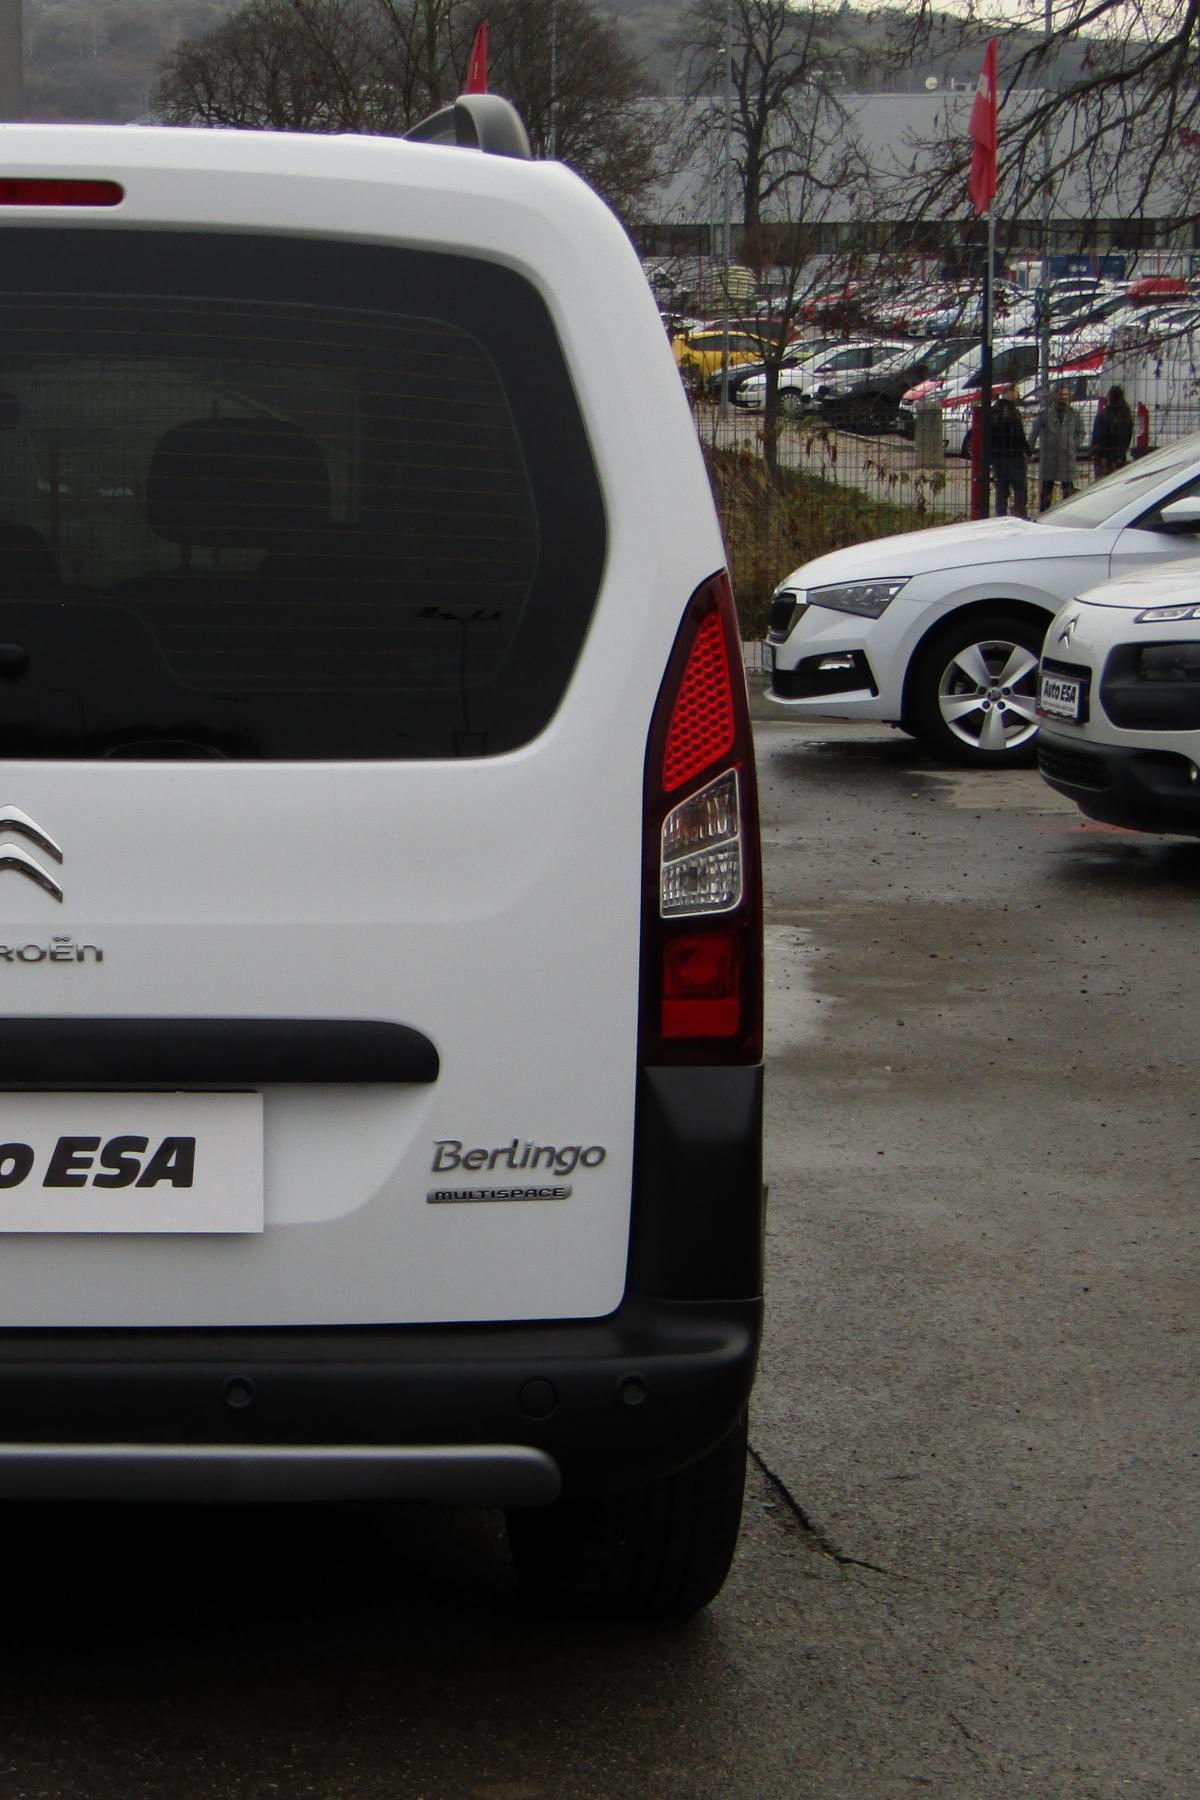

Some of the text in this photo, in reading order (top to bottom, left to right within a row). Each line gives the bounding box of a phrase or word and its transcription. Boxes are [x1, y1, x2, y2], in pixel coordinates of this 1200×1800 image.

[1043, 680, 1076, 704] Auto ESA
[42, 1135, 197, 1189] ESA
[431, 1136, 607, 1176] Berlingo
[435, 1187, 565, 1201] MULTISPACE
